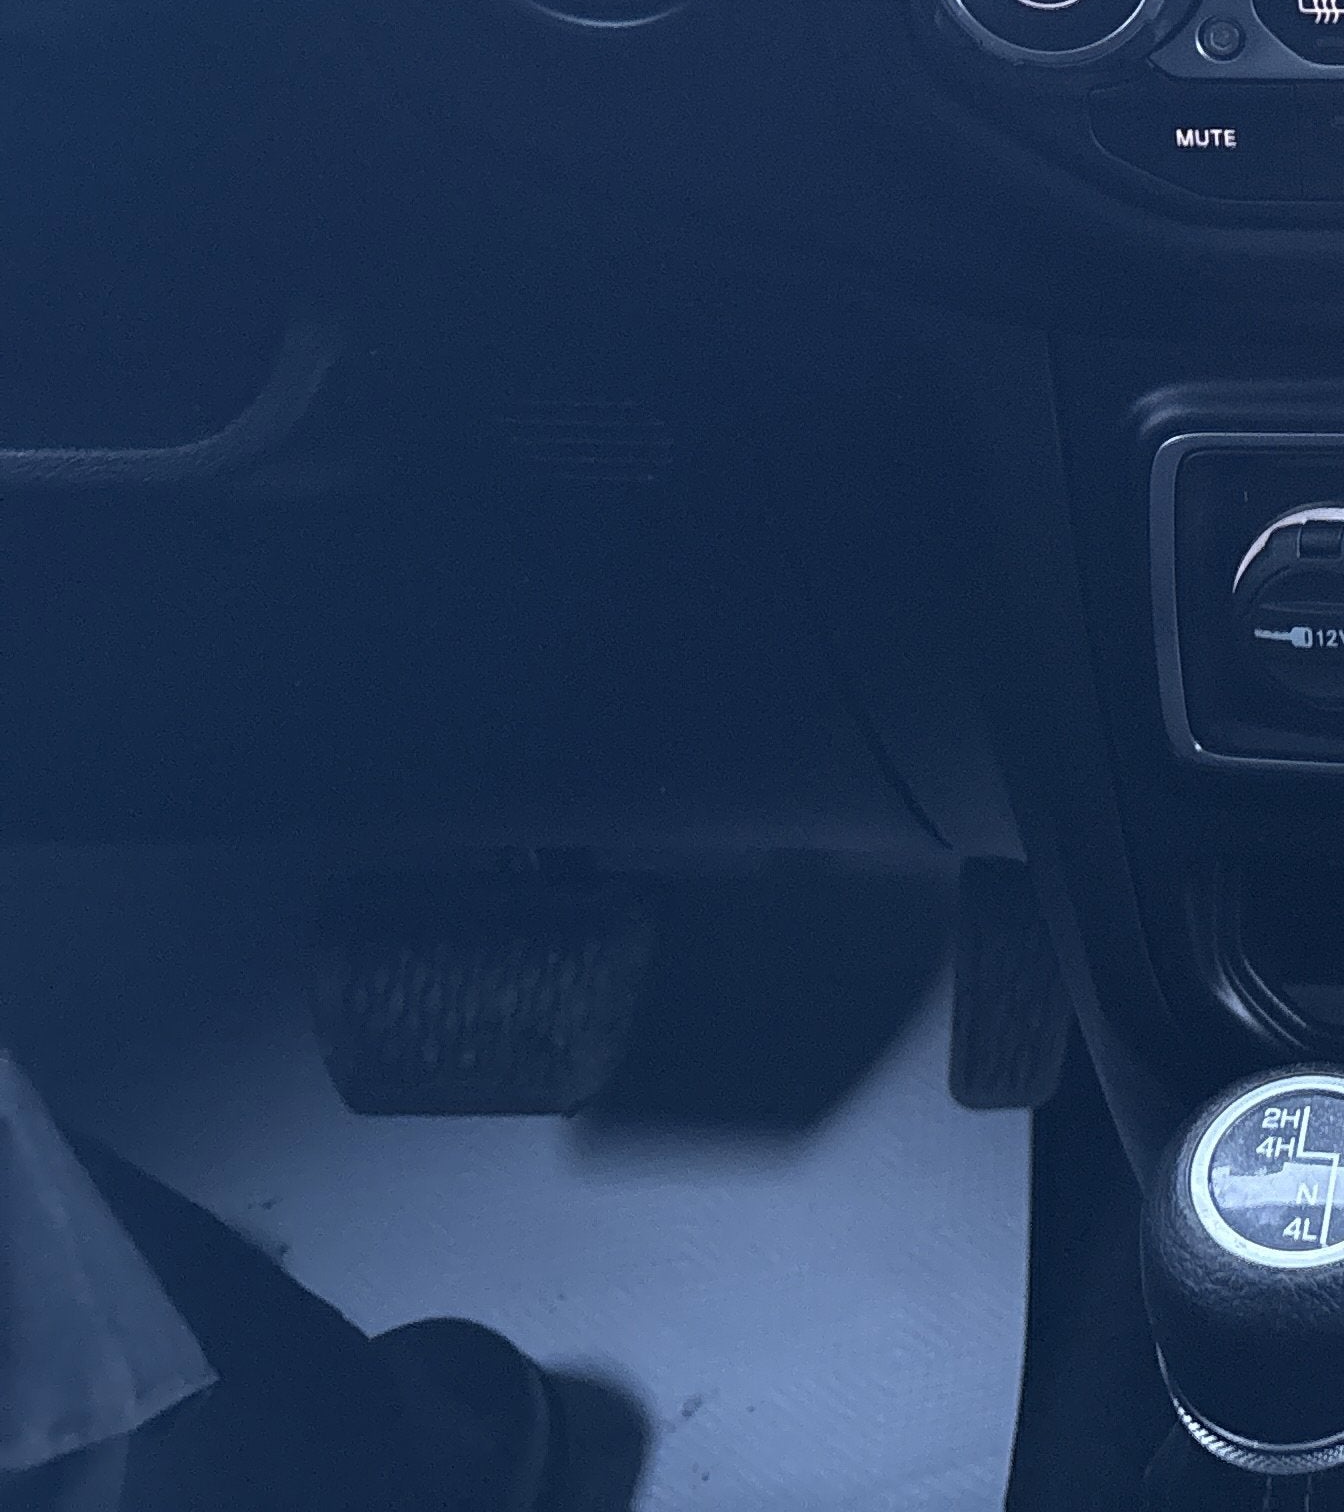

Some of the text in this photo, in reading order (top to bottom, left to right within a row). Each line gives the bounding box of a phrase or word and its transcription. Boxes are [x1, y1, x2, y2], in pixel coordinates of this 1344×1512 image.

[1175, 128, 1237, 148] MUTE
[1262, 1107, 1300, 1129] 2H
[1256, 1135, 1296, 1159] 4H
[1296, 1182, 1319, 1205] N
[1282, 1217, 1317, 1242] 4L
